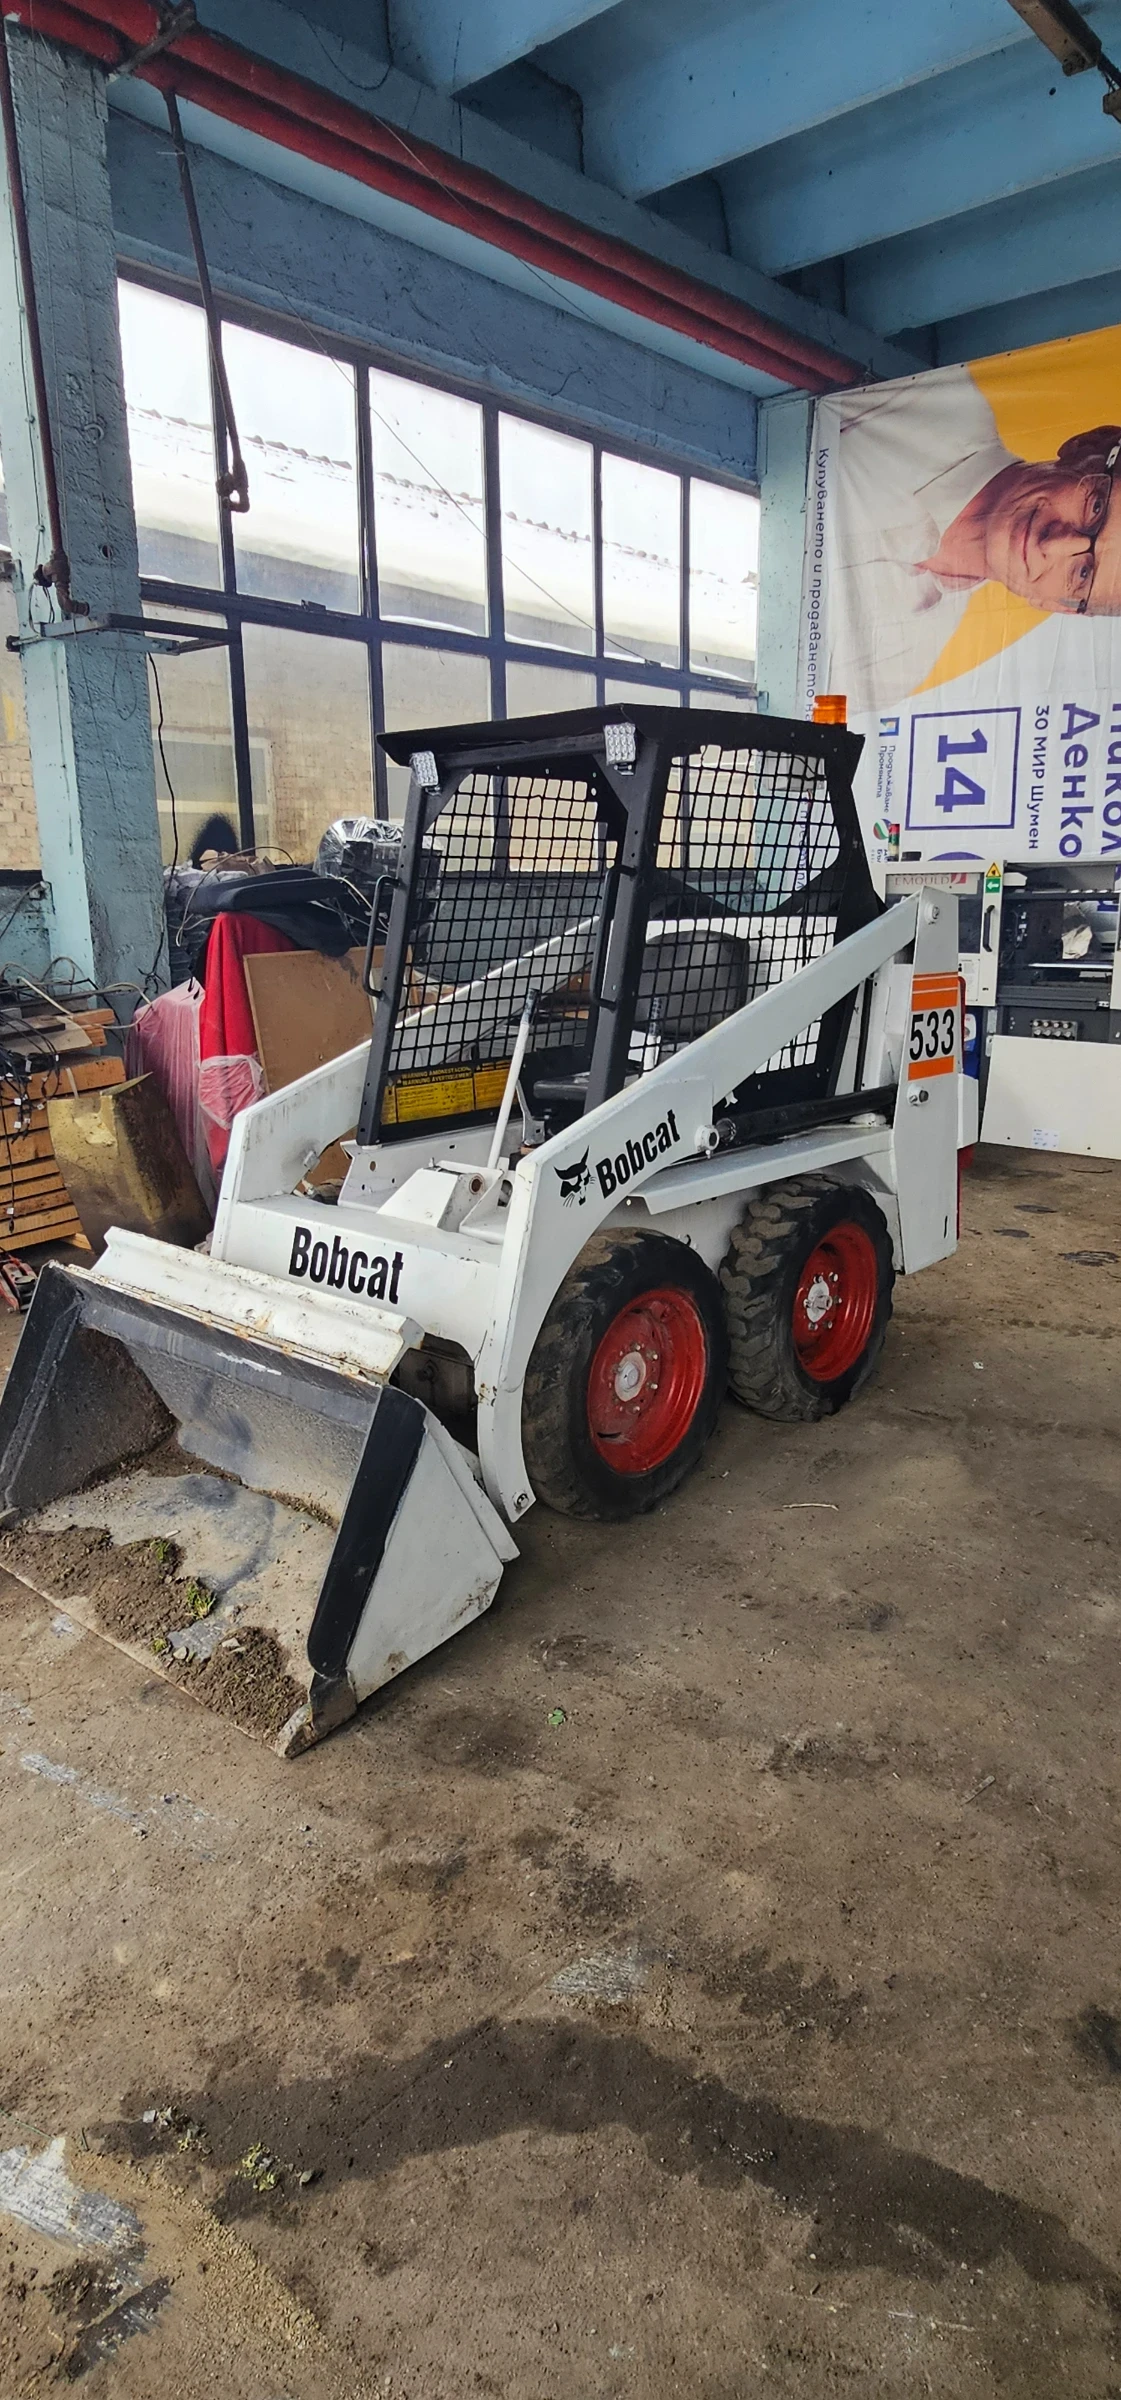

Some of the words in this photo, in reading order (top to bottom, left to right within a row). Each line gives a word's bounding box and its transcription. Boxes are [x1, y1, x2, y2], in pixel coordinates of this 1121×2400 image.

[814, 448, 829, 558] Купуването
[813, 564, 822, 573] и
[806, 579, 822, 698] продаването
[1034, 705, 1050, 730] 30
[876, 746, 888, 798] Промяната
[884, 745, 896, 812] Продължаваме
[935, 728, 988, 813] 14
[1032, 736, 1048, 779] МИР
[1027, 785, 1045, 849] Шумен
[909, 1008, 955, 1061] 533
[596, 1108, 681, 1200] Bobcat
[288, 1226, 404, 1305] Bobcat
